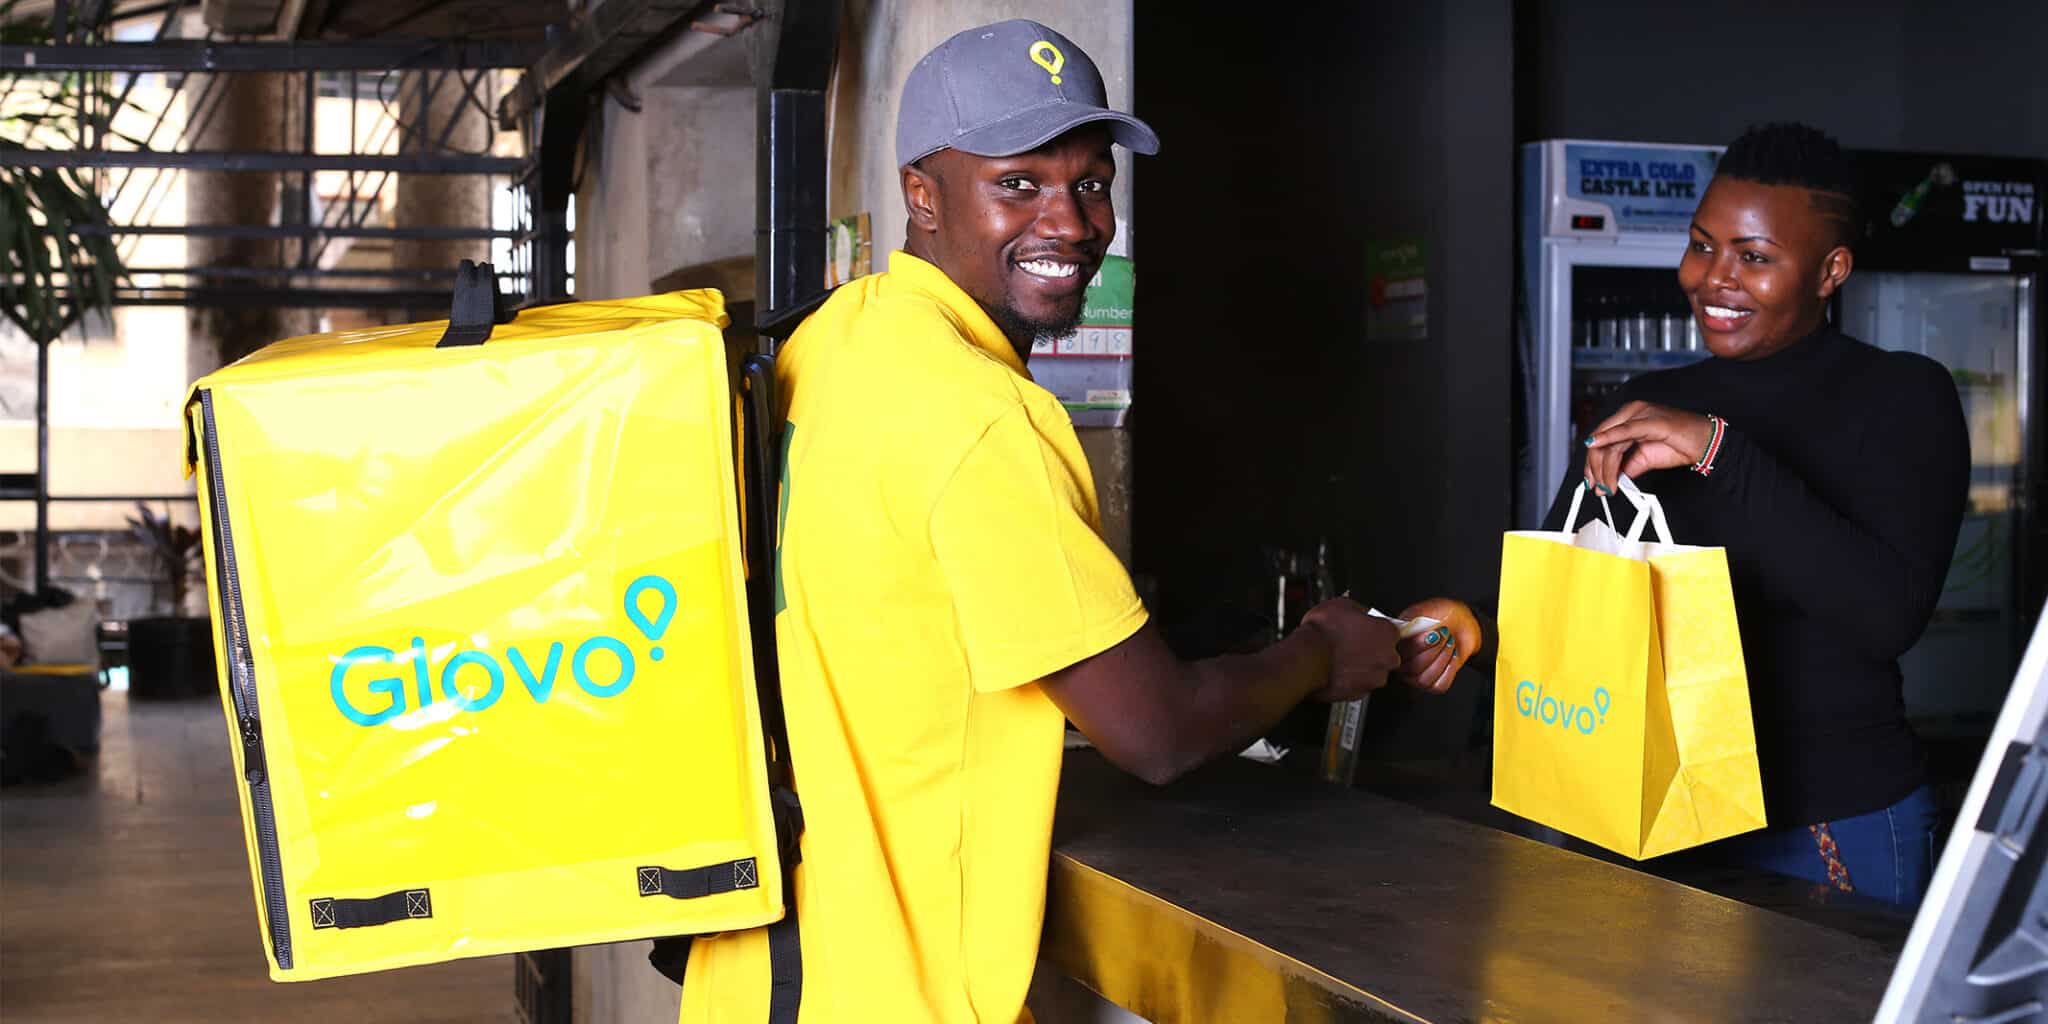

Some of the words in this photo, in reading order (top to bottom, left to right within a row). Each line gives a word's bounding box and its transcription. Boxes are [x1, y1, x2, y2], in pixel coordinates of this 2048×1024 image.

[1581, 160, 1642, 178] EXTRA
[1648, 162, 1695, 180] COLD
[1581, 179, 1649, 195] CASTLE
[1656, 182, 1696, 198] LITE
[1963, 181, 2002, 193] OPEN
[1963, 194, 2034, 223] FUN
